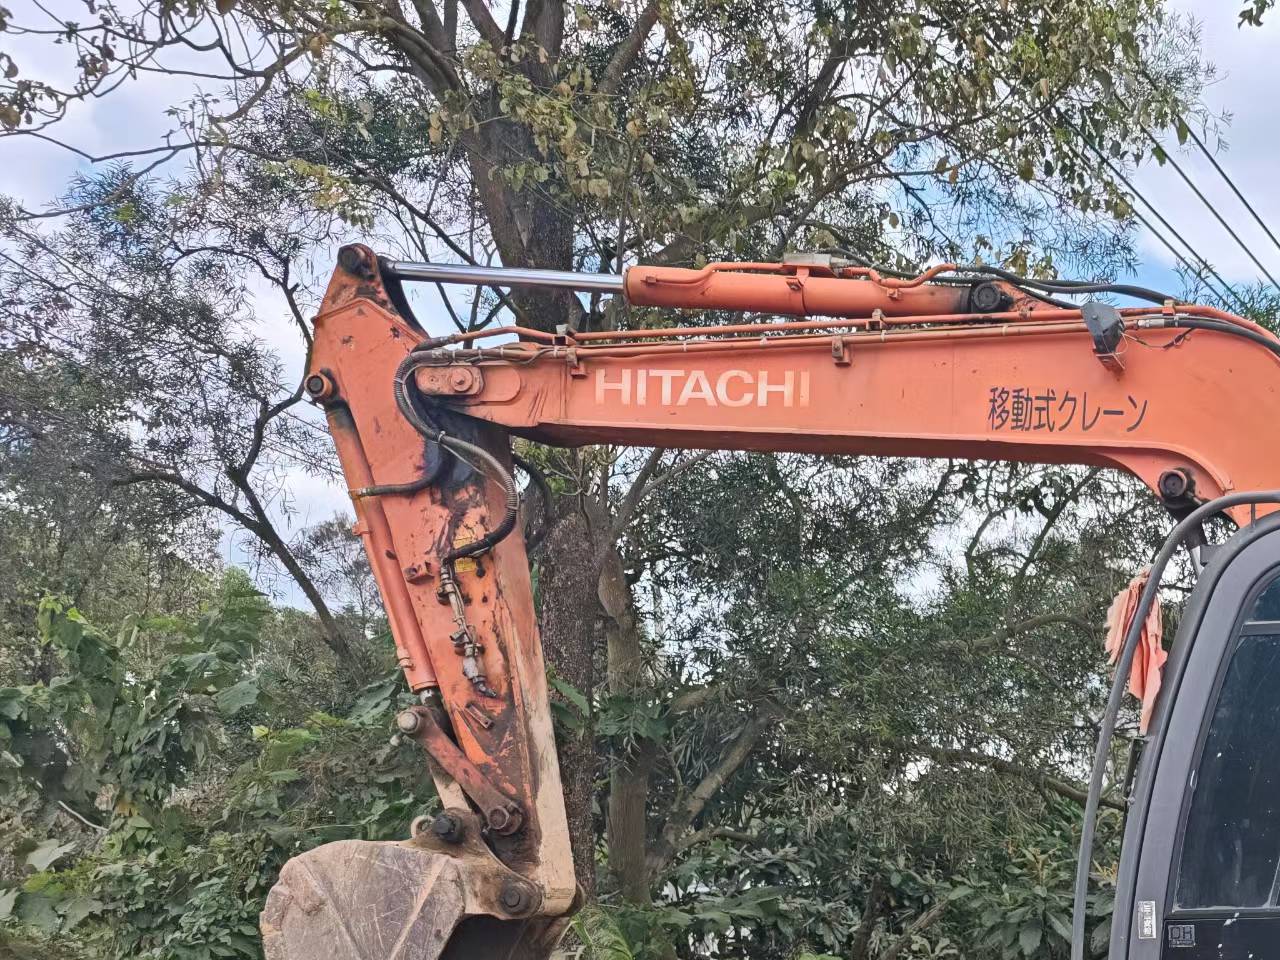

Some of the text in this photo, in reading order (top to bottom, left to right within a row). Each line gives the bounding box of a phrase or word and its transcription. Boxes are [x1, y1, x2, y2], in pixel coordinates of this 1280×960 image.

[595, 368, 810, 407] HITACHI
[988, 386, 1148, 433] 移動式クレーン
